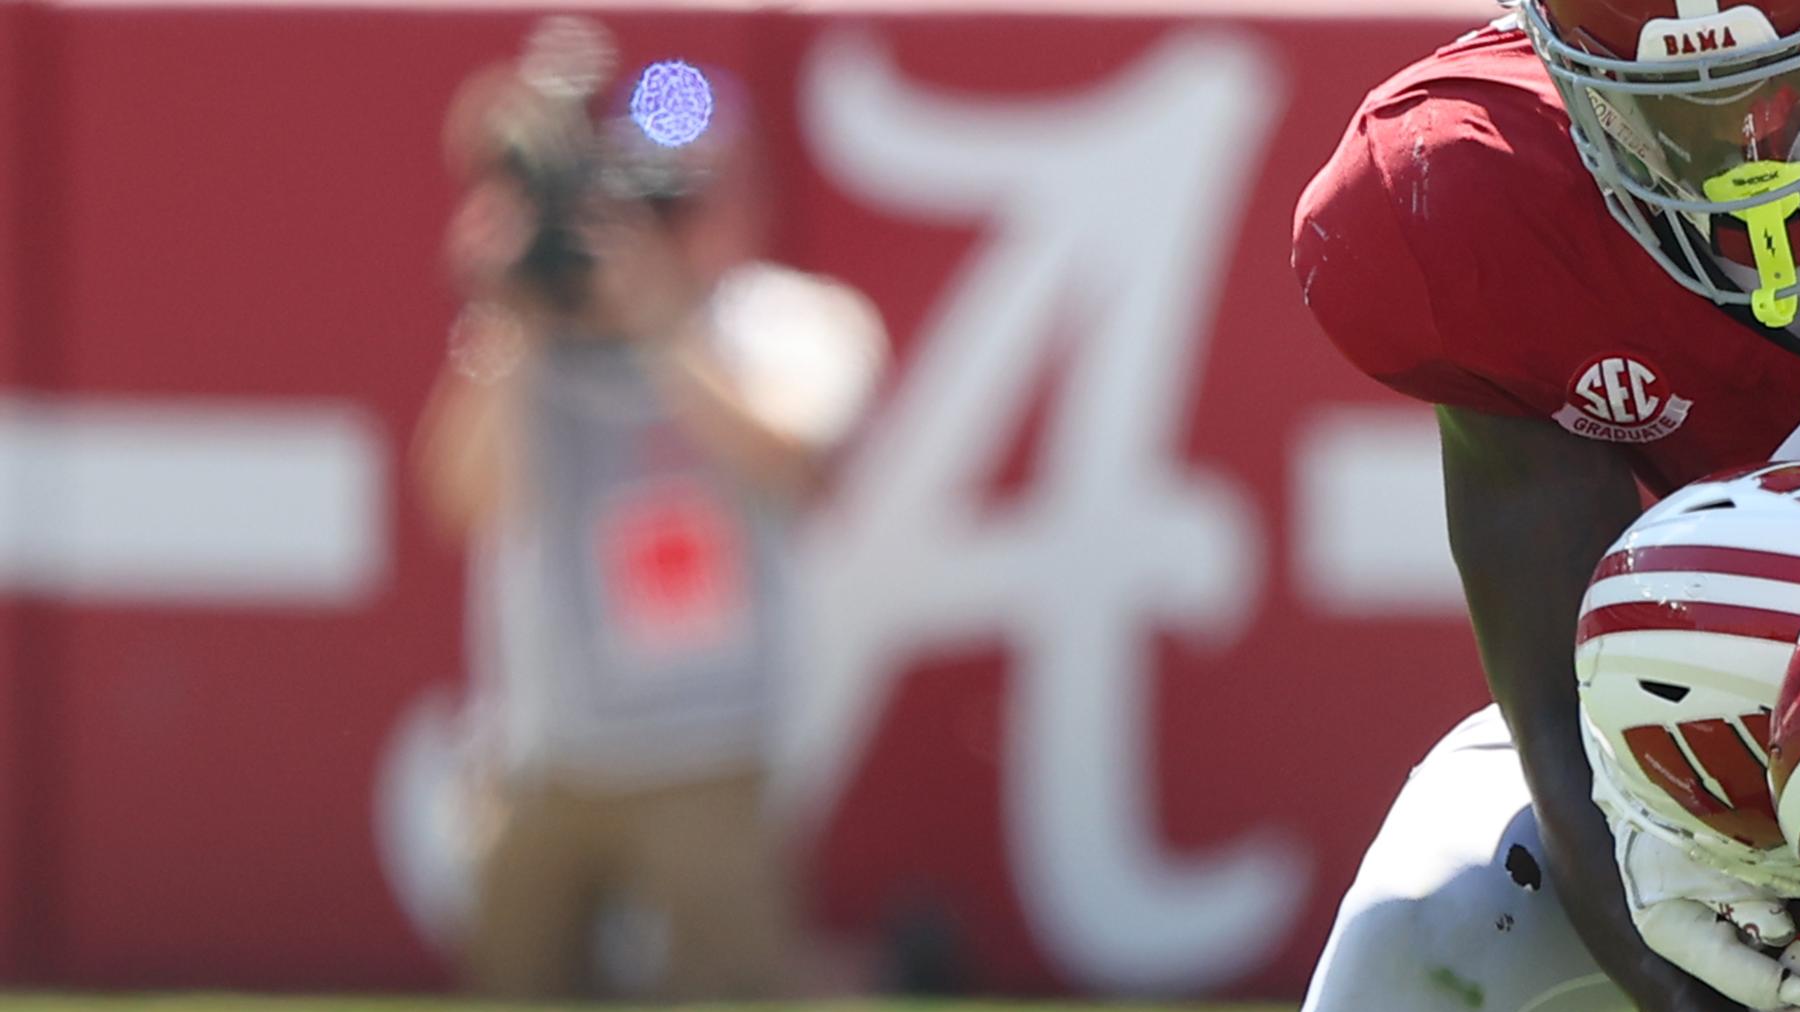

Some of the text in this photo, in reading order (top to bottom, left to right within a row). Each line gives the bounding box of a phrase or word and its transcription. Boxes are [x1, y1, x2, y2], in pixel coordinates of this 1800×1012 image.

[1663, 26, 1736, 56] BAMA
[1575, 357, 1660, 424] SEC
[1573, 416, 1677, 442] GRADUATE
